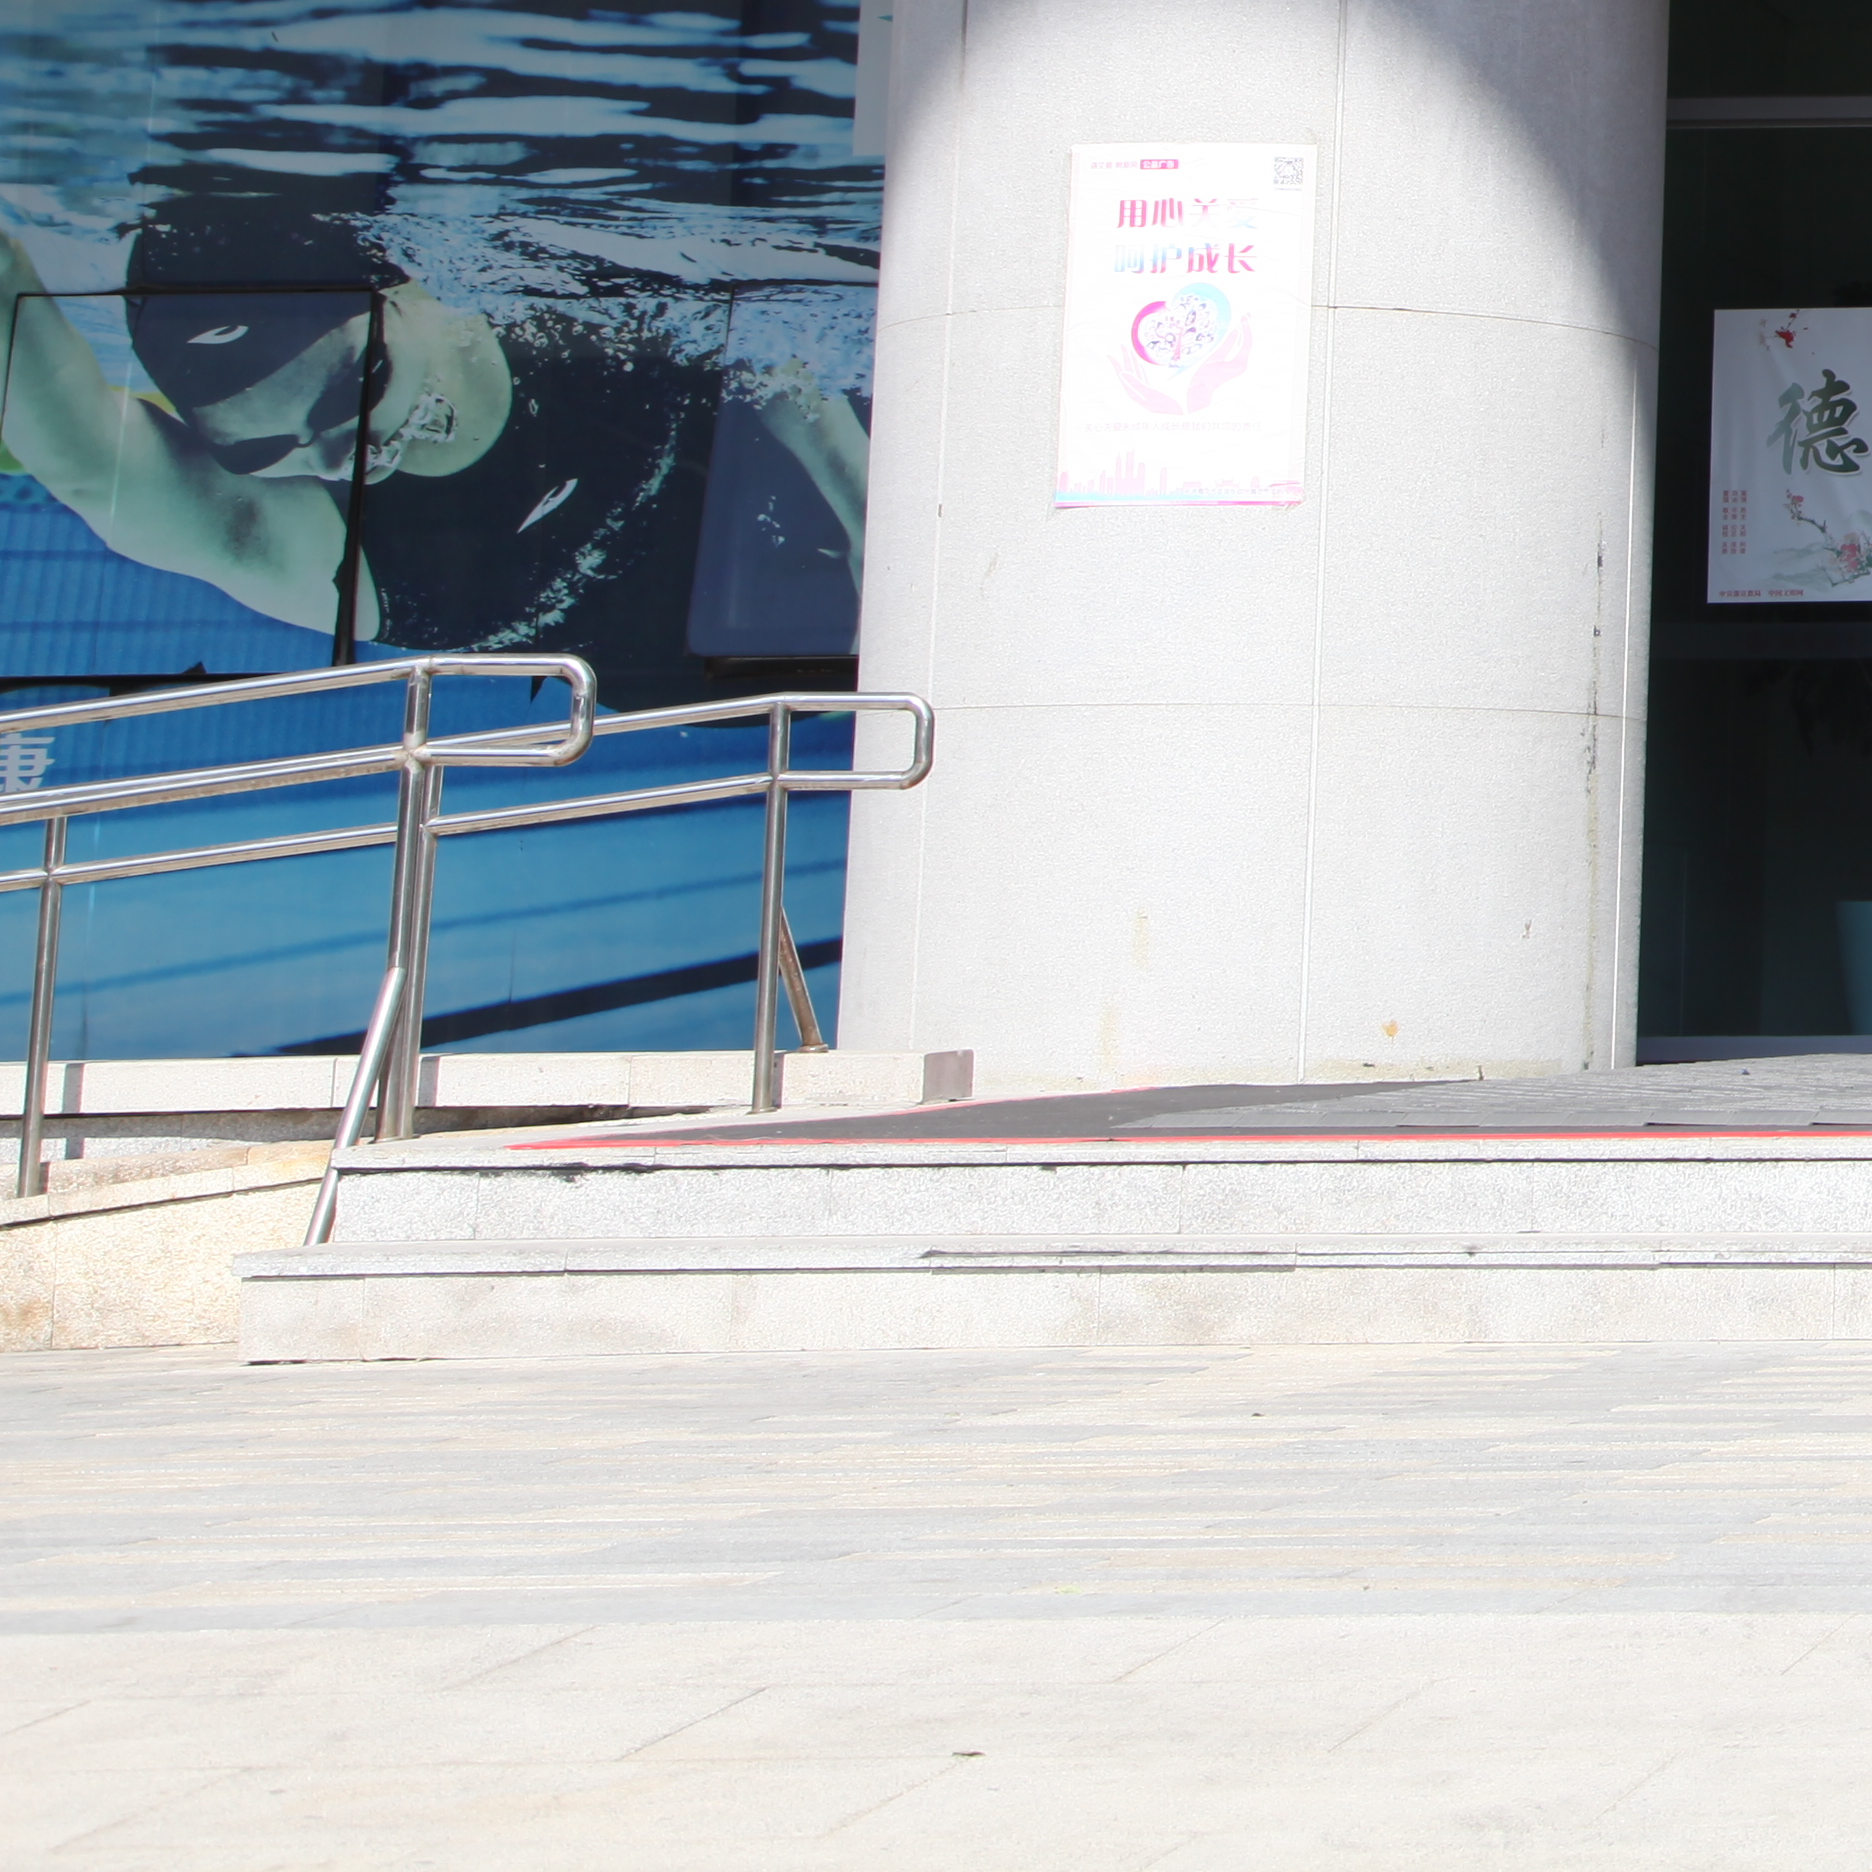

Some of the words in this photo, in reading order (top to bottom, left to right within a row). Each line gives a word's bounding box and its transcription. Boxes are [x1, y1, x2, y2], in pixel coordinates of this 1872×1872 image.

[1116, 197, 1258, 229] 用心关爱
[1114, 243, 1257, 274] 呵护成长
[1766, 368, 1870, 476] 德
